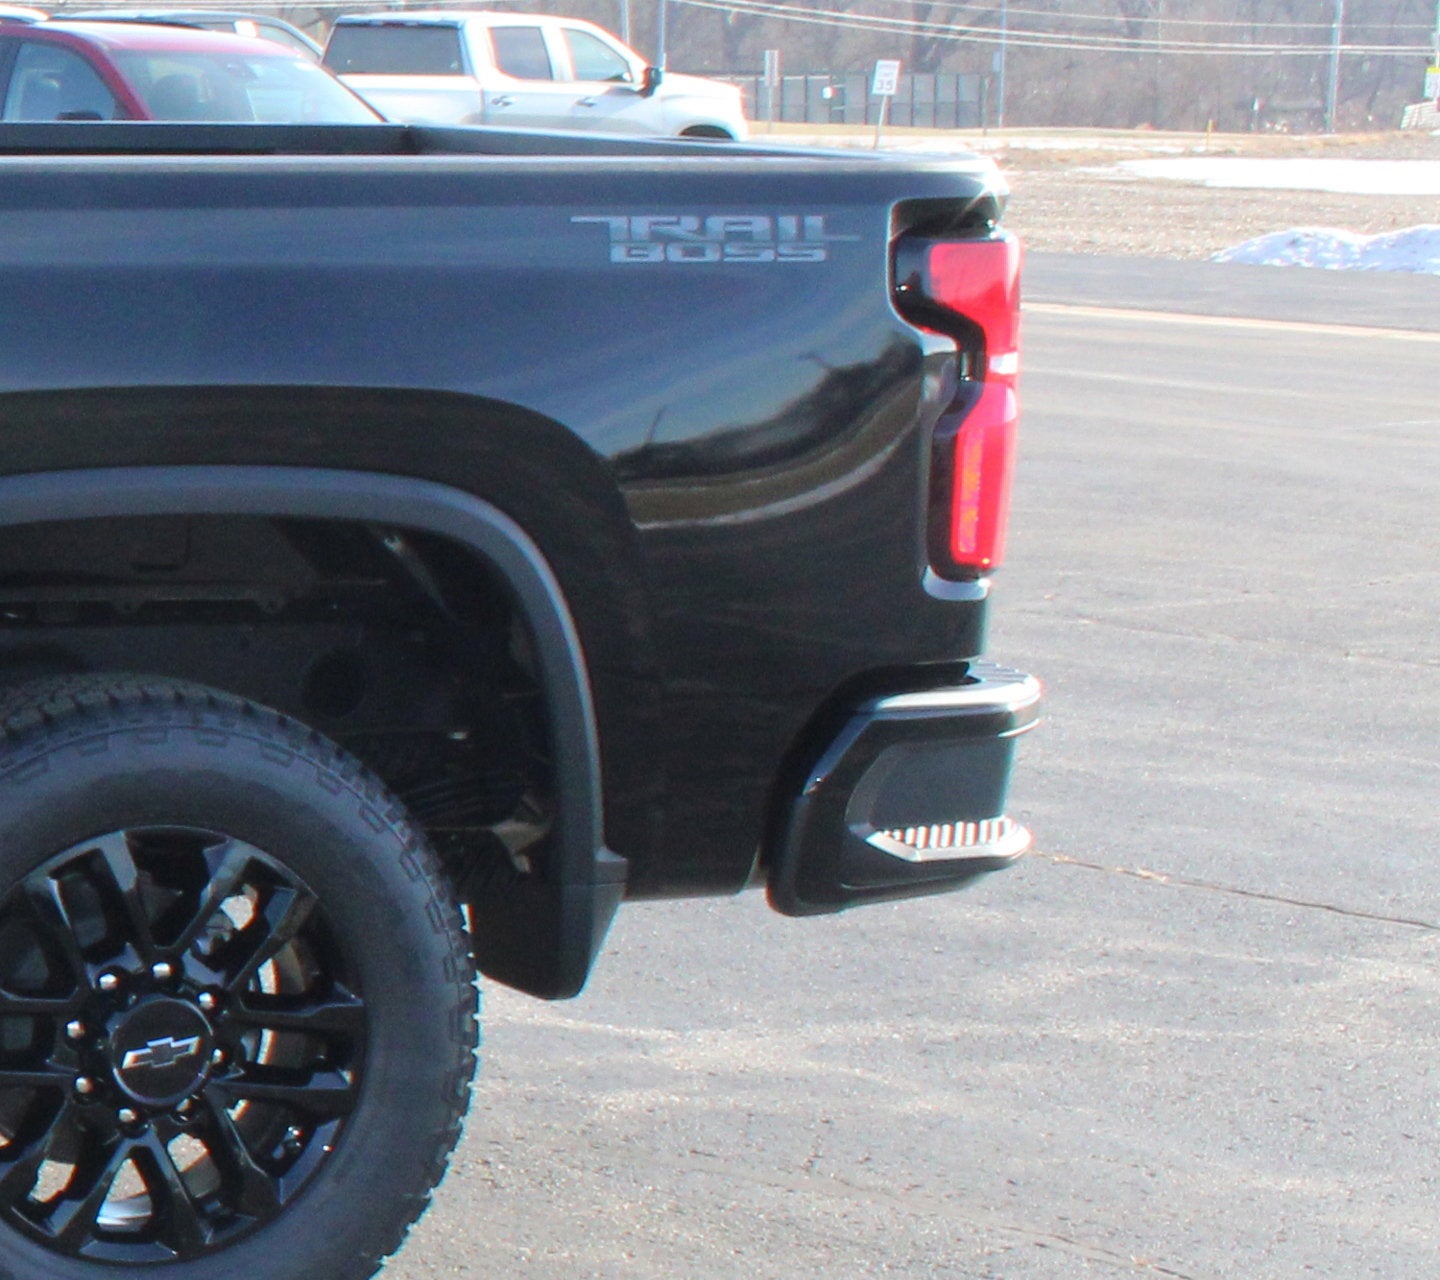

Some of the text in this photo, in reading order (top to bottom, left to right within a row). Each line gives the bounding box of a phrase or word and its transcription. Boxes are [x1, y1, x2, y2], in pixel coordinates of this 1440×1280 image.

[875, 79, 894, 91] 35
[570, 214, 862, 241] TRAIL
[610, 243, 828, 263] BOSS
